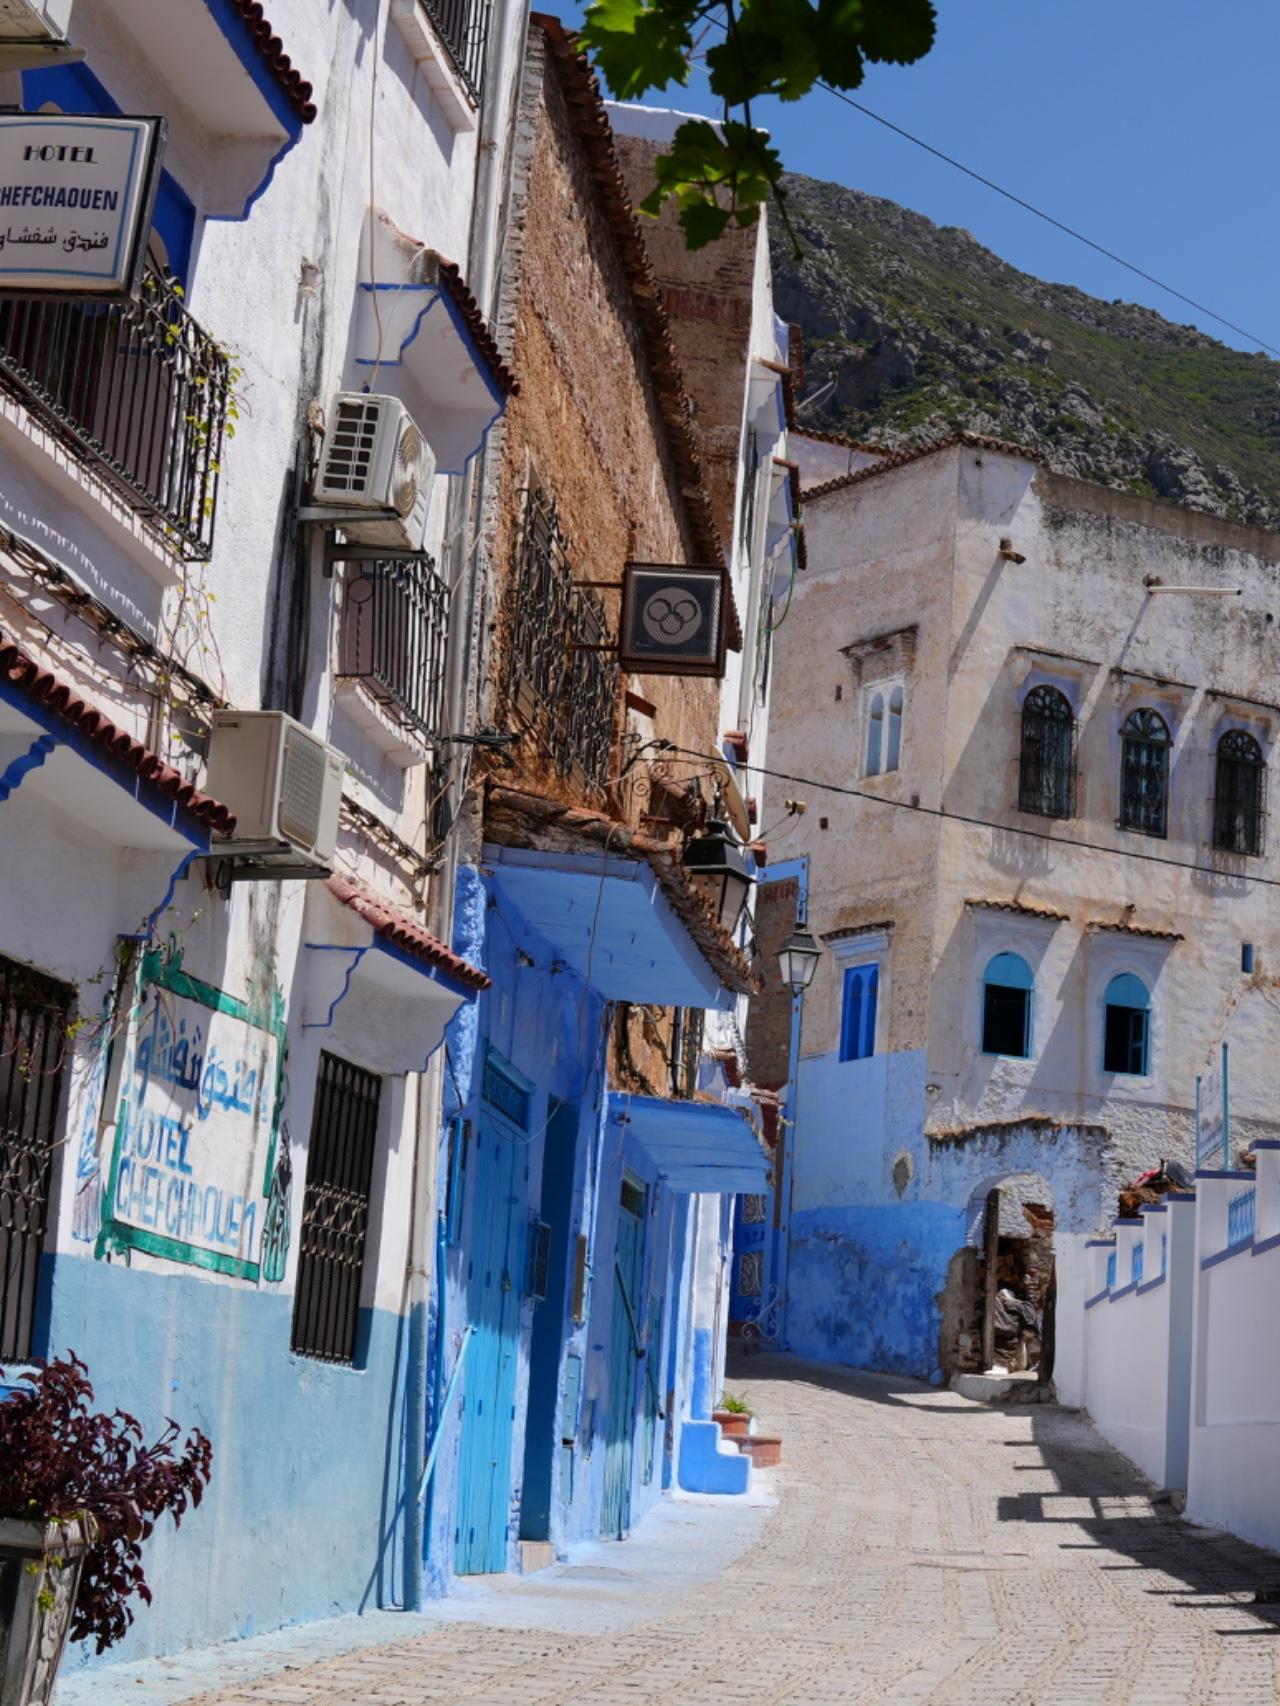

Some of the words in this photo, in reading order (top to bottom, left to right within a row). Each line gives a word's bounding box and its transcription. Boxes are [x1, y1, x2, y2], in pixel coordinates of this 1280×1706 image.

[23, 145, 98, 164] HOTEL
[0, 186, 118, 211] HEFCHAOUEN
[62, 230, 109, 253] فندق
[120, 1101, 193, 1176] HOTEL
